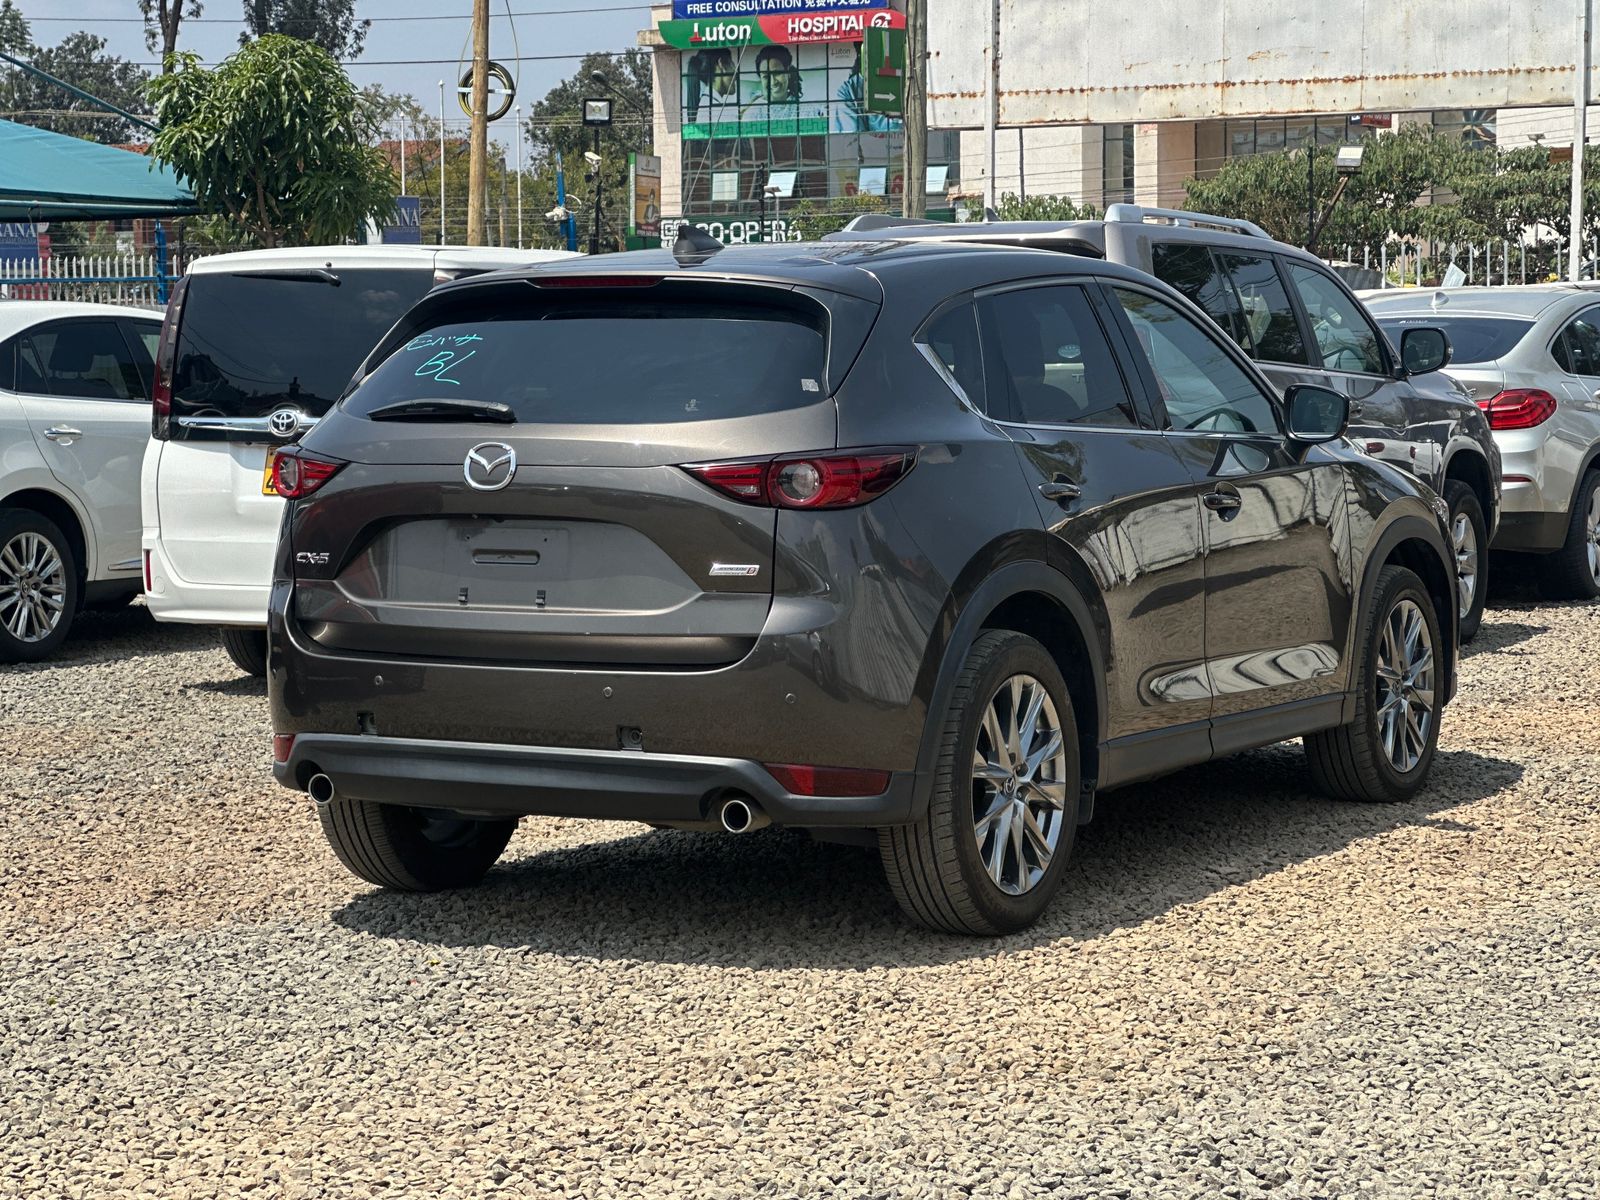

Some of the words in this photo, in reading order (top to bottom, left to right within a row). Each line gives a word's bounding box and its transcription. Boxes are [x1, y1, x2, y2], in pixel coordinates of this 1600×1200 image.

[687, 3, 713, 14] FREE
[715, 0, 802, 12] CONSULTATION
[689, 22, 751, 42] Luton
[296, 551, 330, 564] CX-5
